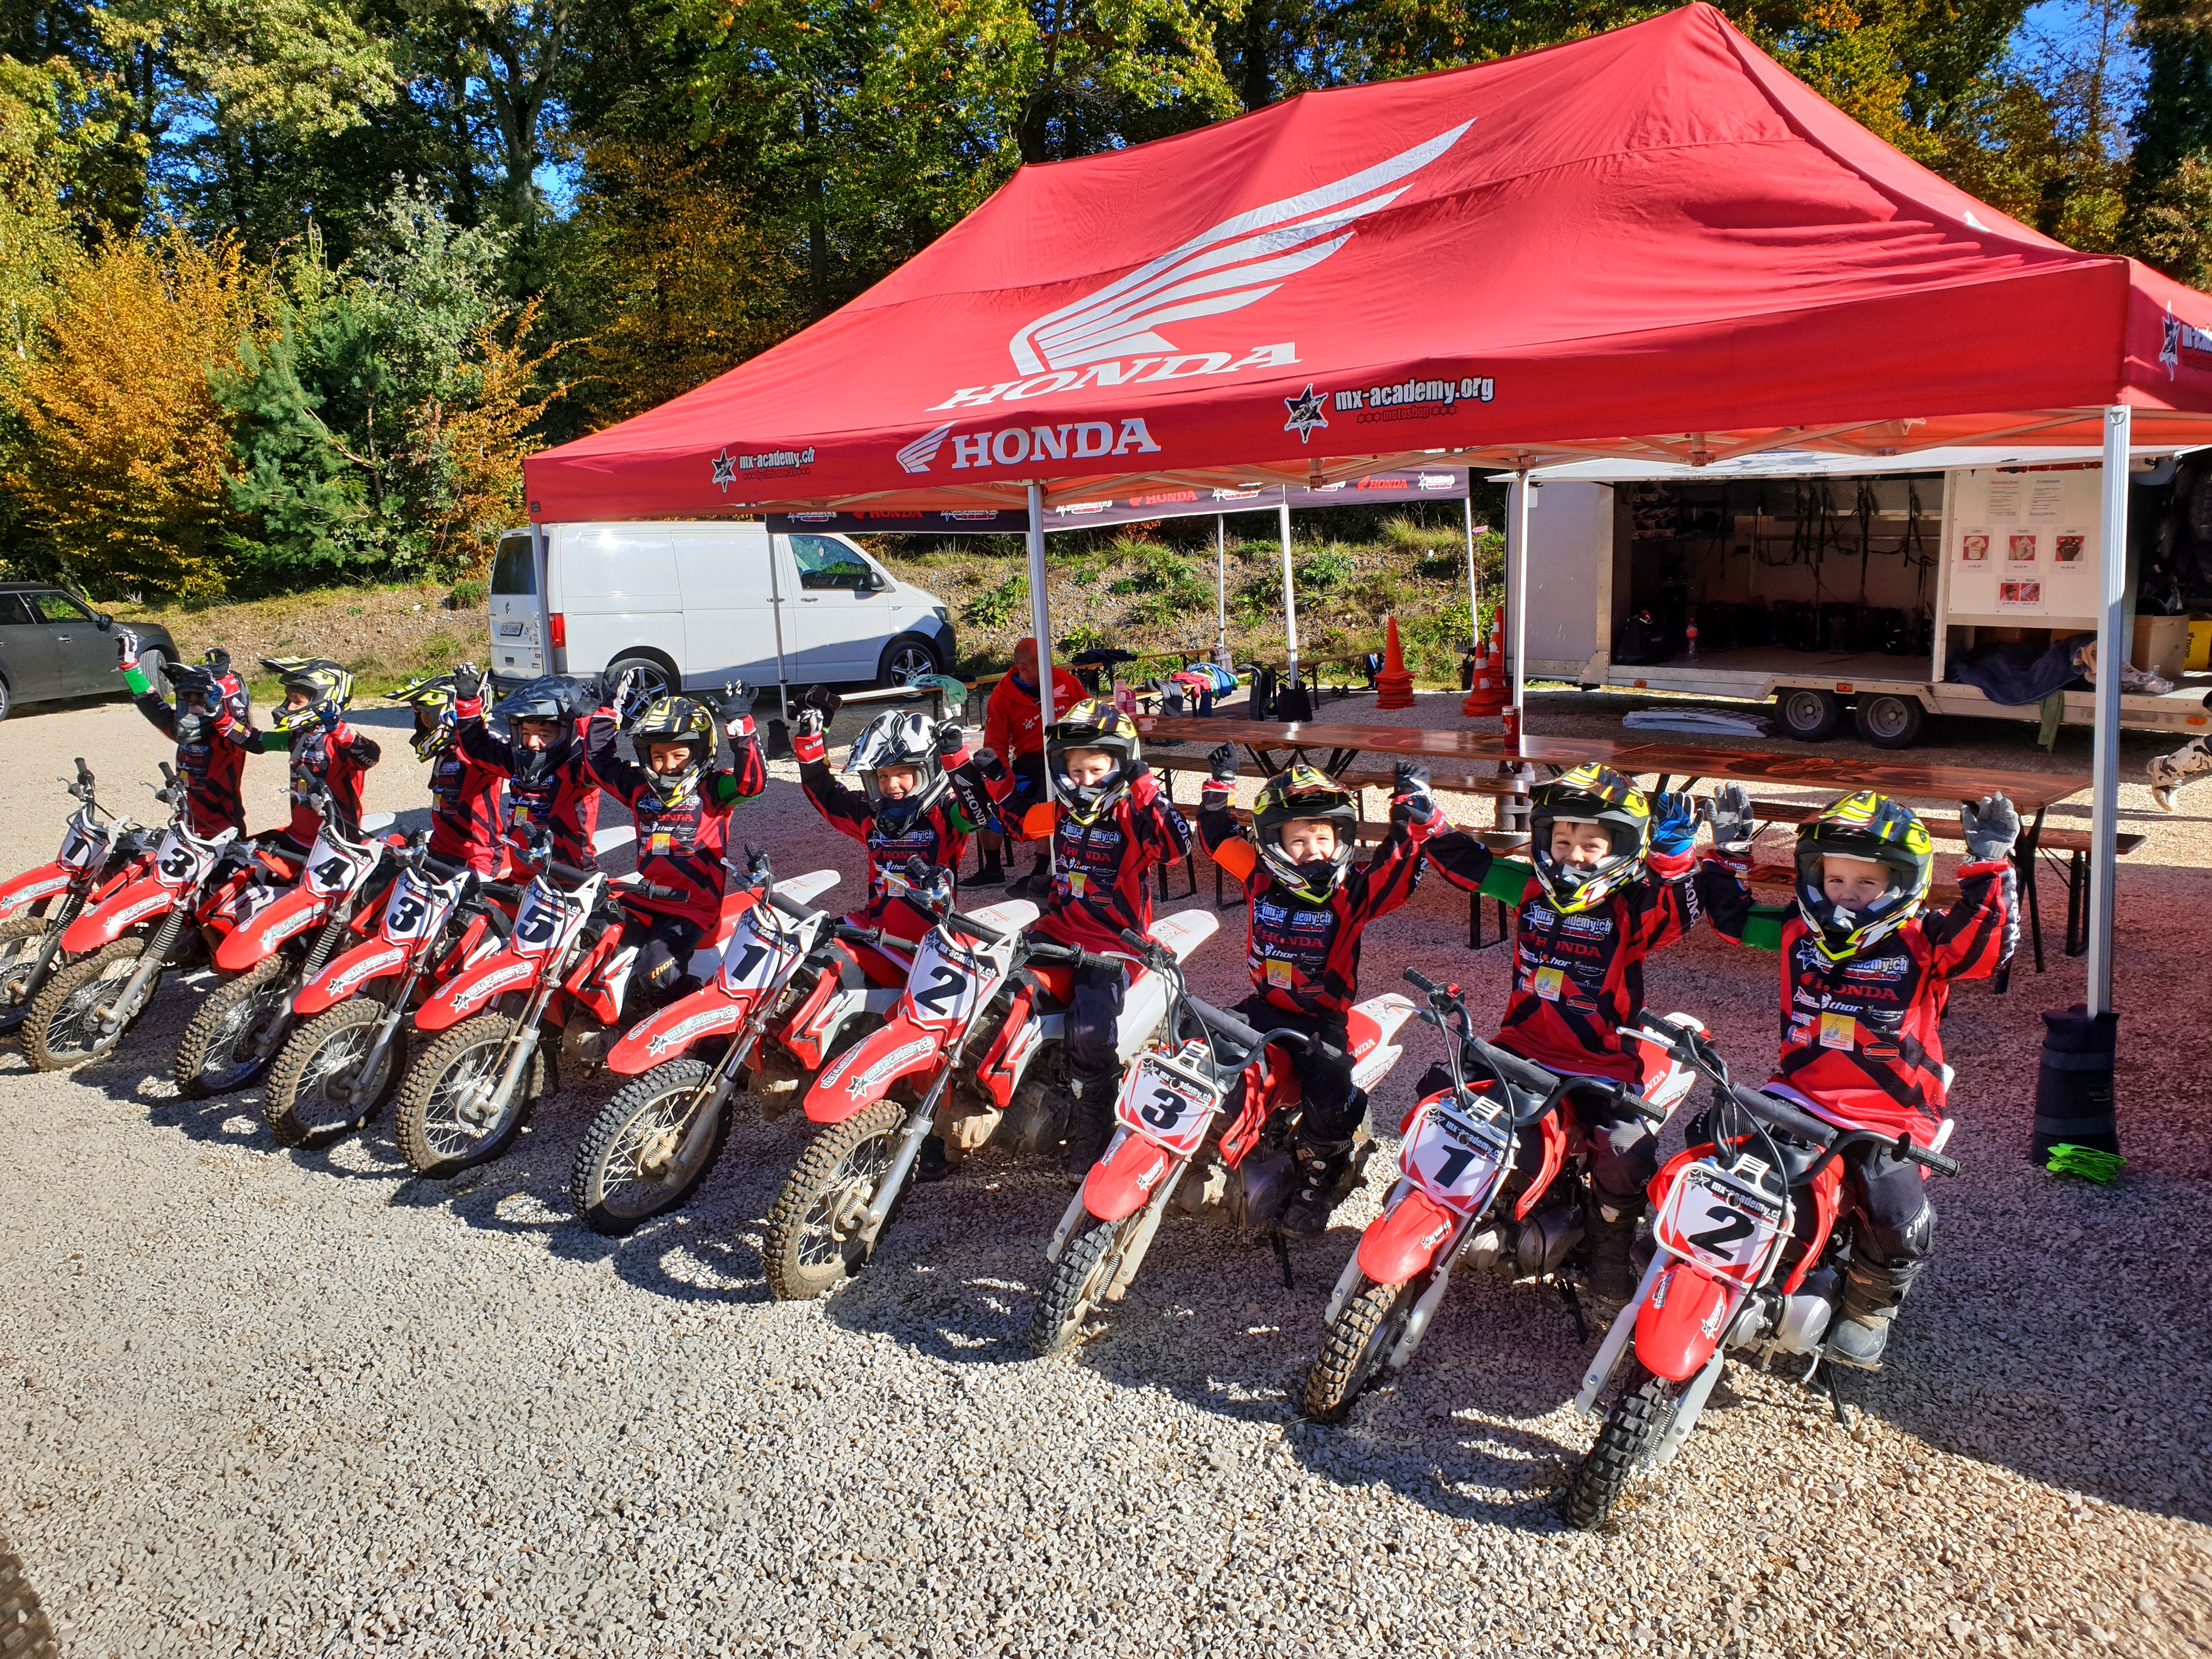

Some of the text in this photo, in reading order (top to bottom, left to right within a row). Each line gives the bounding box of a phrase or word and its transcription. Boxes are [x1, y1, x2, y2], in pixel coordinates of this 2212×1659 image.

[925, 342, 1302, 411] HONDA
[1335, 377, 1494, 411] mx-academy.org
[1382, 405, 1430, 422] motoshop
[739, 447, 815, 470] mx-academy.ch
[951, 418, 1161, 469] HONDA
[1146, 490, 1198, 505] HONDA
[1368, 479, 1408, 489] HONDA
[870, 510, 924, 518] HONDA
[65, 836, 88, 861] 1
[161, 848, 195, 878] 3
[314, 856, 352, 889] 4
[388, 896, 425, 932] 3
[517, 905, 564, 943] 5
[343, 949, 403, 981] mx-academy.ch
[651, 957, 675, 980] thor
[731, 943, 768, 982] 1
[1272, 950, 1297, 959] thor
[469, 962, 532, 997] mx-academy.ch
[913, 966, 968, 1017] 2
[667, 1006, 738, 1040] mx-academy.ch
[1829, 1002, 1864, 1012] thor
[866, 1037, 933, 1081] mx-academy.ch
[1141, 1088, 1187, 1130] 3
[1433, 1144, 1476, 1189] 1
[1688, 1205, 1755, 1262] 2
[1906, 1201, 1931, 1239] thor
